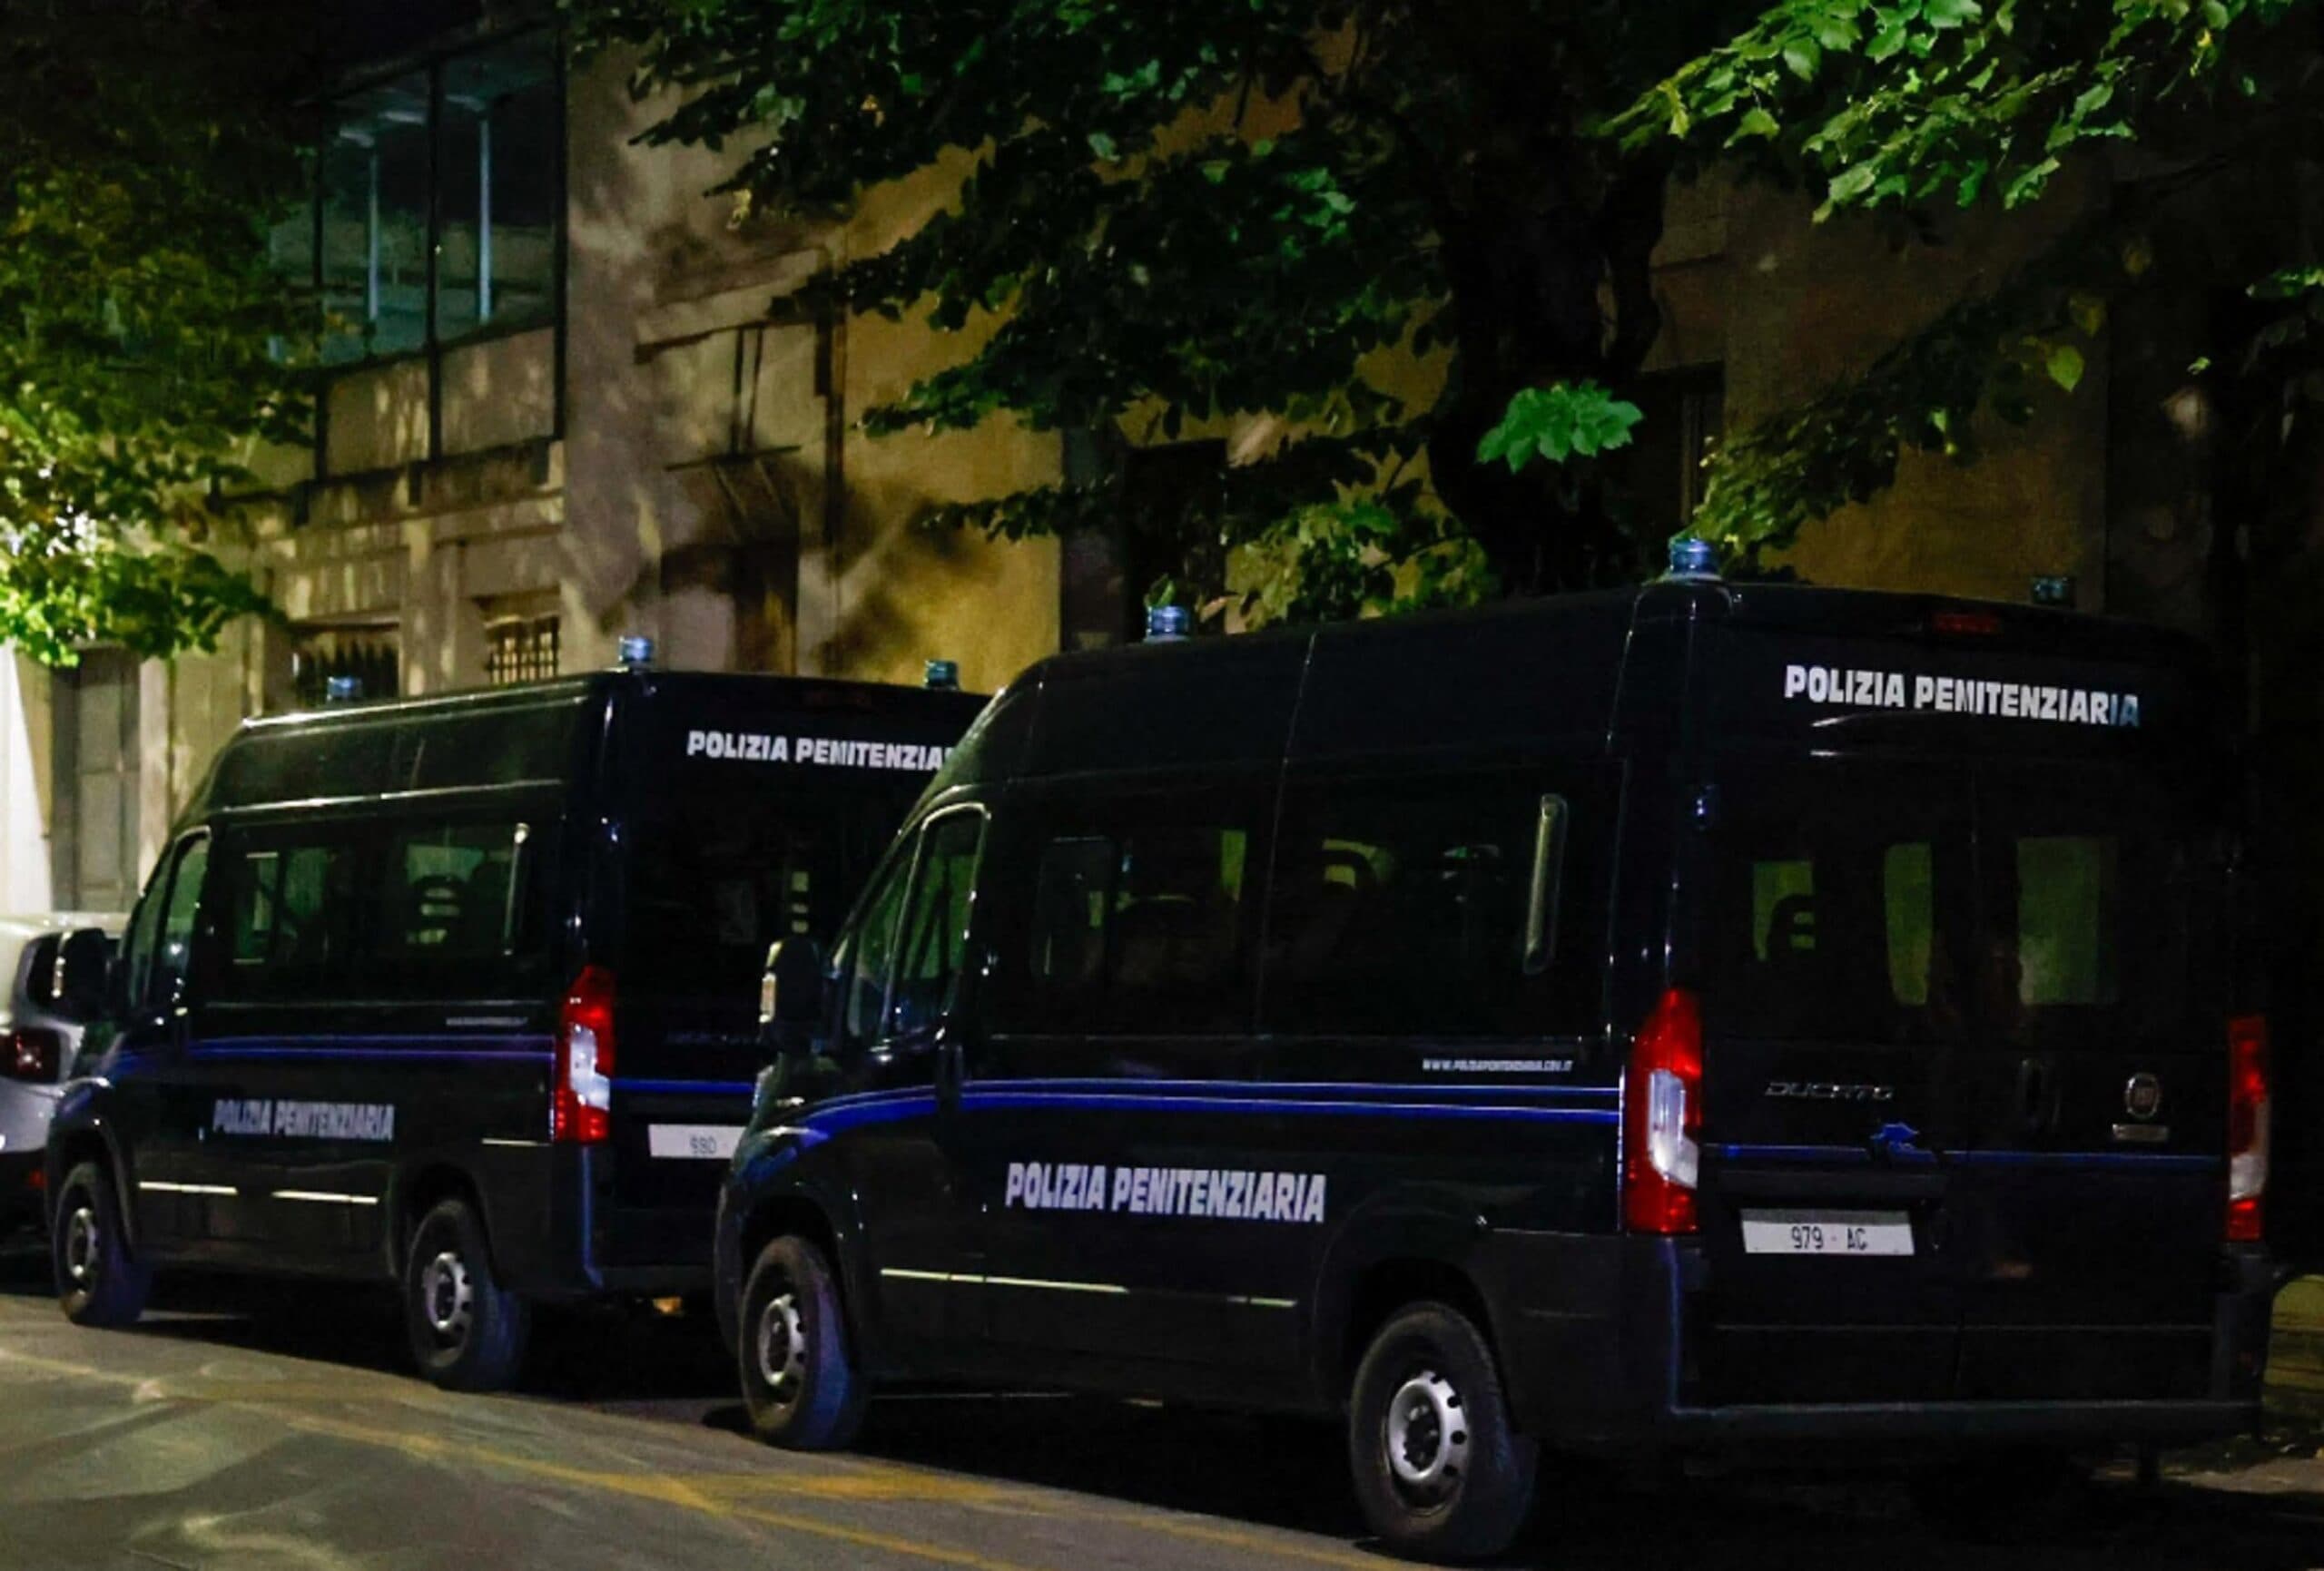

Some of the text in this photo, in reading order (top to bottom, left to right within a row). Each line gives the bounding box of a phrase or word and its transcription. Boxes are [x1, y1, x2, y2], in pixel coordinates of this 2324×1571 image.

[1784, 664, 2142, 727] POLIZIA PENITENZIARIA
[686, 730, 955, 771] POLIZIA PENITENZIA
[212, 1098, 397, 1143] POLIZIA PENITENZIARIA
[1005, 1161, 1327, 1223] POLIZIA PENITENZIARIA
[1791, 1225, 1824, 1250] 979
